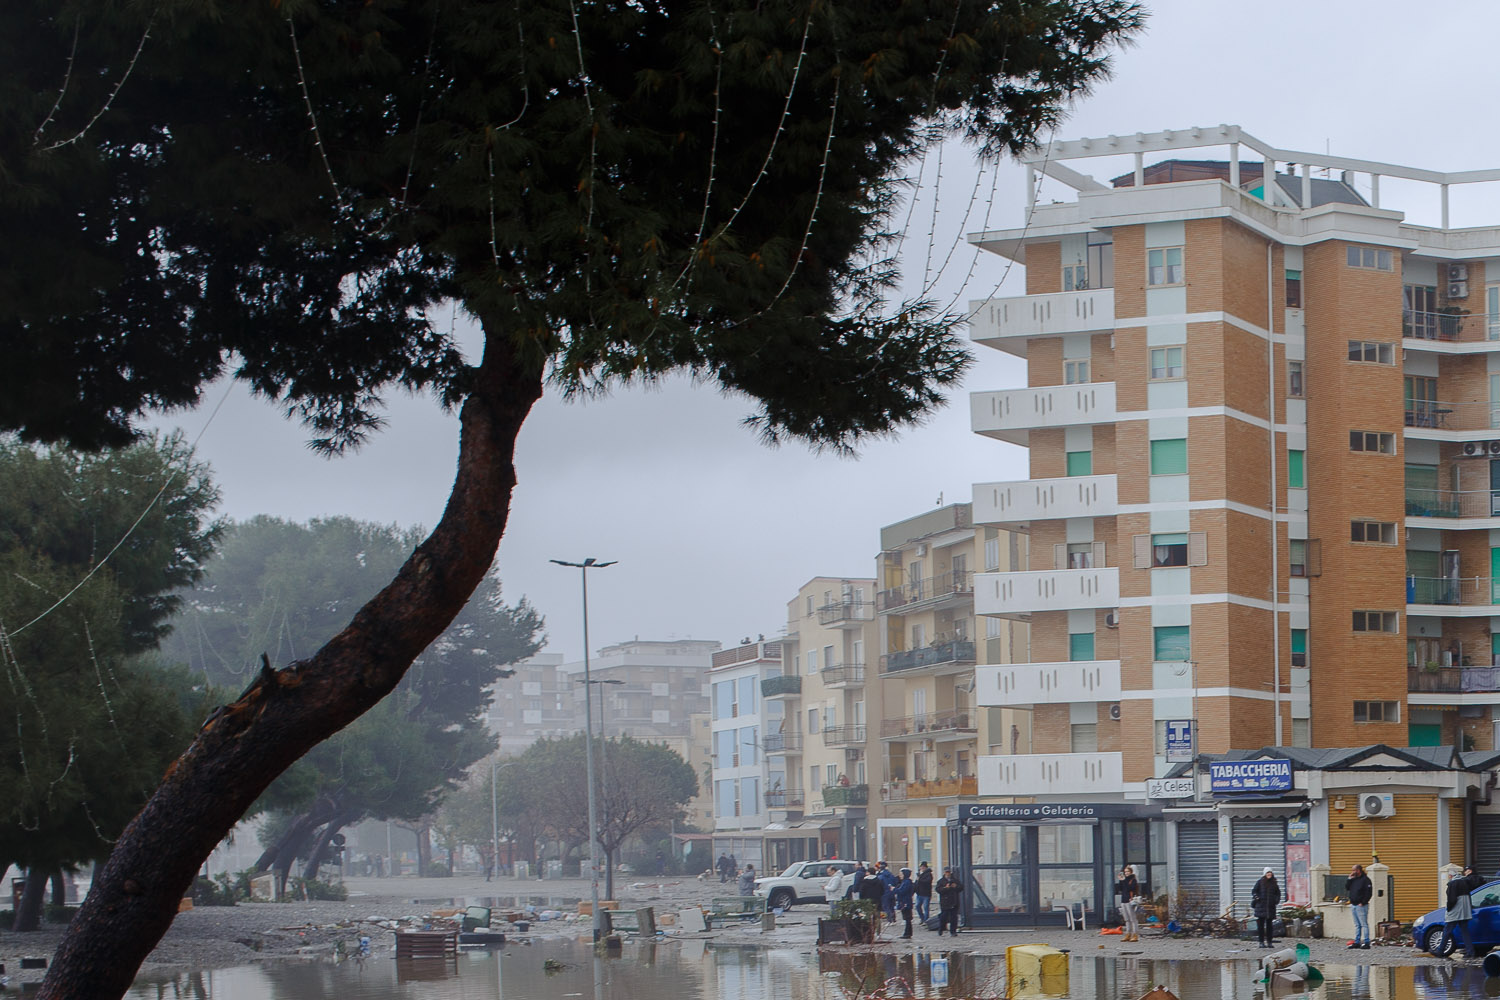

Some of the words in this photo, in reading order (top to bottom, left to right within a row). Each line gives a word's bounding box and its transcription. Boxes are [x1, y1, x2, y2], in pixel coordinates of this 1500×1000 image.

[1169, 721, 1189, 741] T
[1211, 763, 1290, 778] TABACCHERIA
[969, 806, 1031, 816] Caffetteria
[1041, 805, 1094, 816] Gelateria
